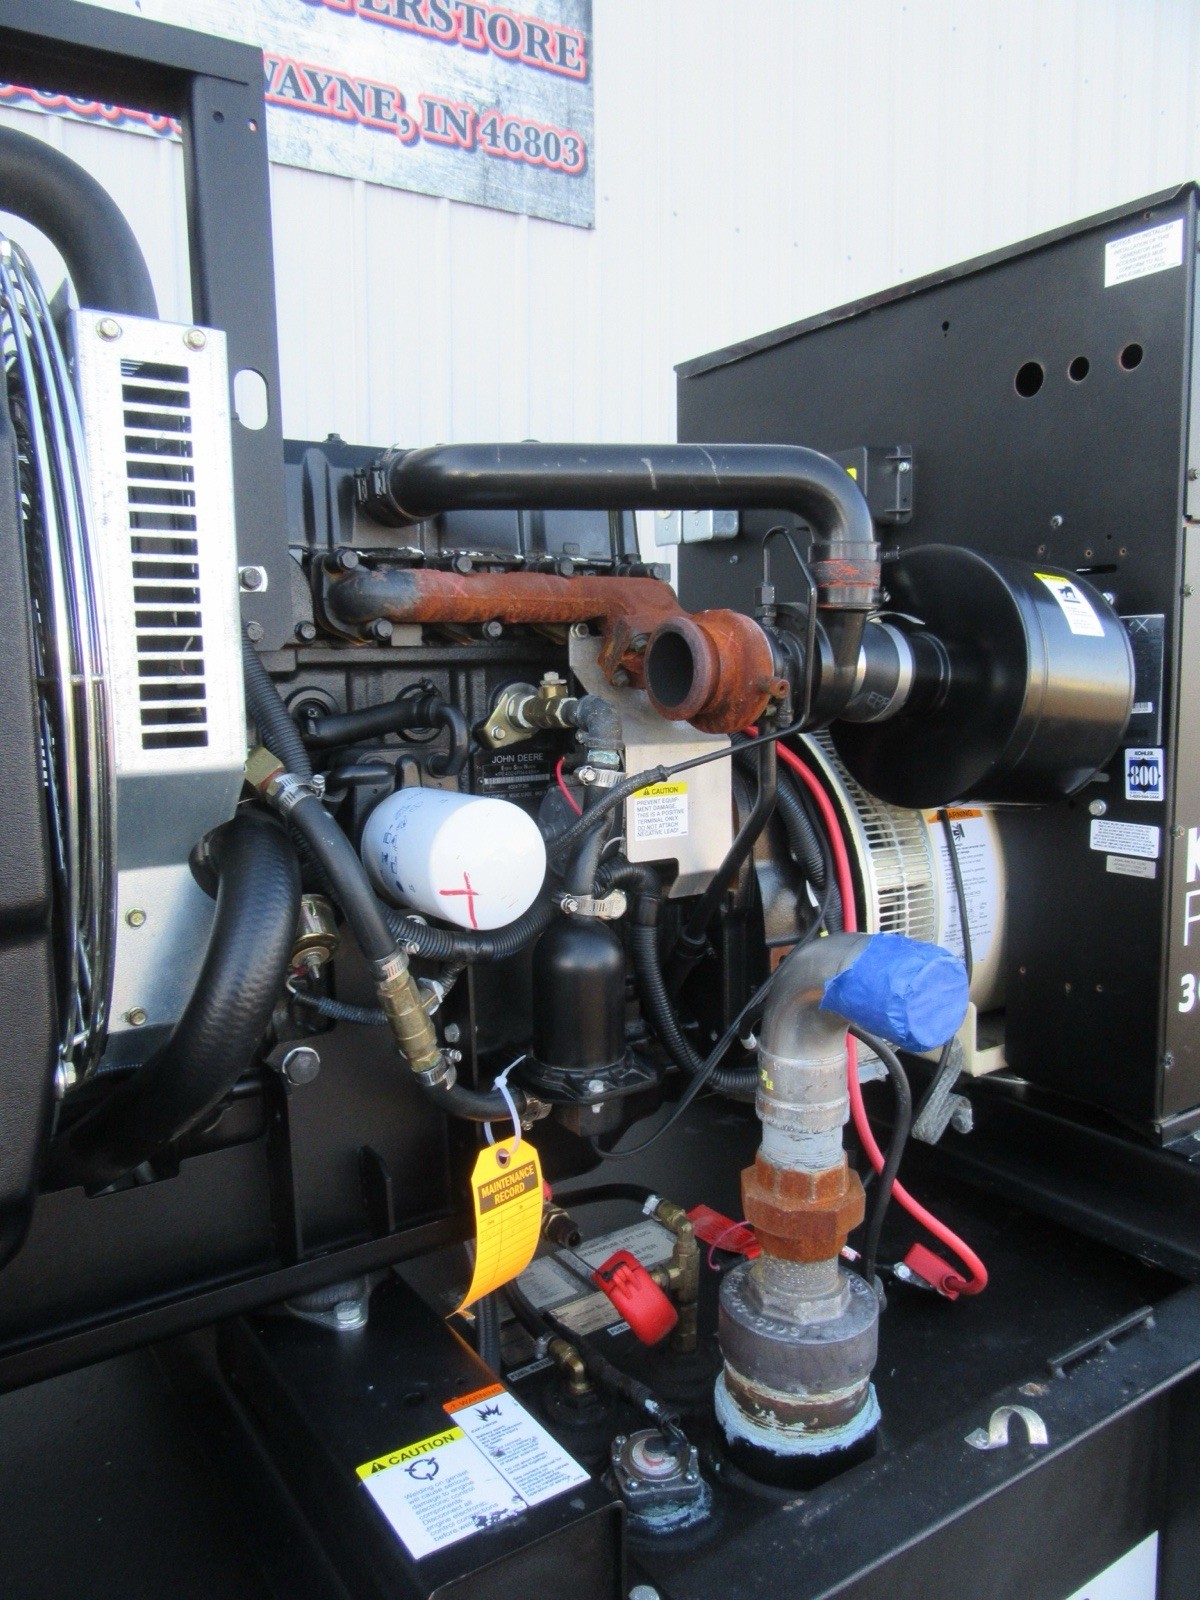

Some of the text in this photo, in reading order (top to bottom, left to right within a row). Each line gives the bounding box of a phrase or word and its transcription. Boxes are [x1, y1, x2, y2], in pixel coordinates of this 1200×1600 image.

[421, 98, 470, 142] IN
[481, 115, 581, 168] 46803
[491, 752, 544, 764] JOHN DEERE
[1130, 765, 1158, 786] 800
[651, 787, 678, 795] CAUTION
[949, 809, 974, 819] ARNING
[482, 1164, 535, 1199] MAINTENANCE
[494, 1182, 525, 1205] RECORD
[388, 1433, 455, 1465] CAUTION
[404, 1484, 433, 1499] Welding
[444, 1469, 468, 1482] genset
[412, 1494, 441, 1510] damage
[450, 1480, 474, 1493] engine
[421, 1487, 442, 1499] cause
[443, 1475, 469, 1489] serious
[415, 1486, 475, 1515] electronic control
[422, 1504, 462, 1525] Disconnect
[426, 1517, 451, 1531] engine
[429, 1522, 454, 1536] control
[433, 1528, 457, 1541] before
